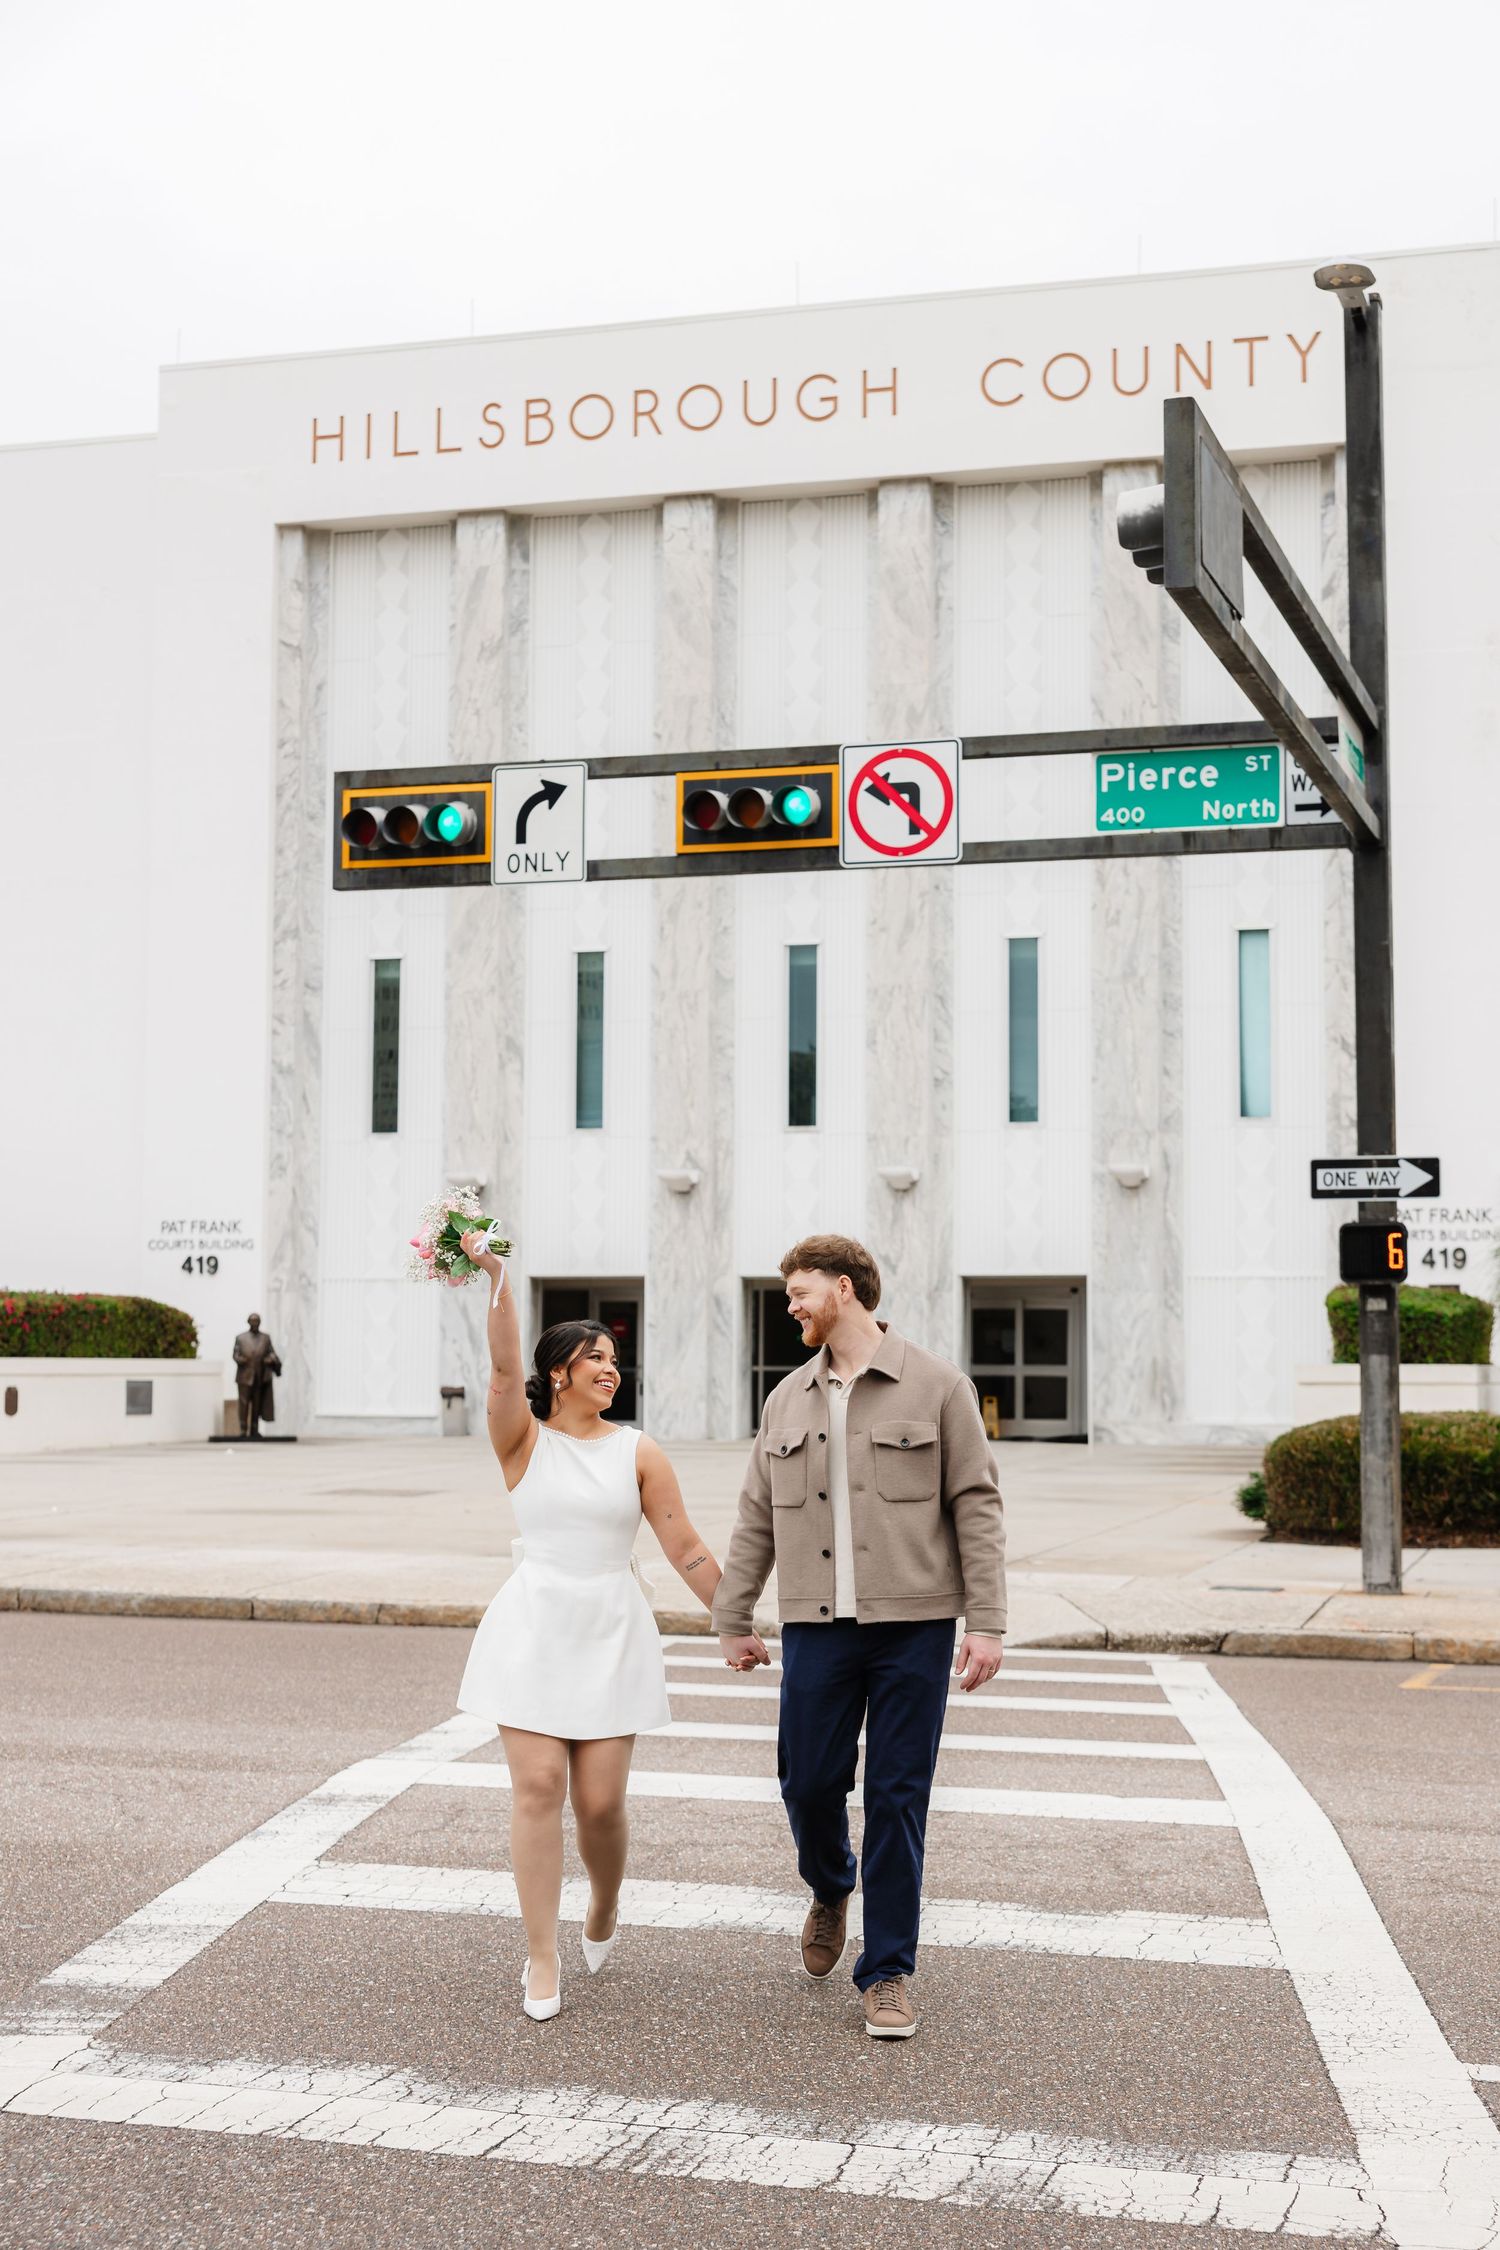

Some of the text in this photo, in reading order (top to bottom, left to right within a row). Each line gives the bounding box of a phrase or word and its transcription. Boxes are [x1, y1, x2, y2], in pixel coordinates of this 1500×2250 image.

[312, 331, 1321, 464] HILLSBOROUGH COUNTY
[1100, 755, 1272, 793] Pierce ST
[1100, 798, 1276, 824] 400 North
[507, 851, 570, 873] ONLY
[1322, 1170, 1400, 1187] ONE WAY
[160, 1220, 242, 1233] PAT FRANK
[1429, 1208, 1493, 1223] FRANK
[1387, 1232, 1404, 1270] 6
[1422, 1247, 1467, 1269] 419
[181, 1255, 219, 1275] 419
